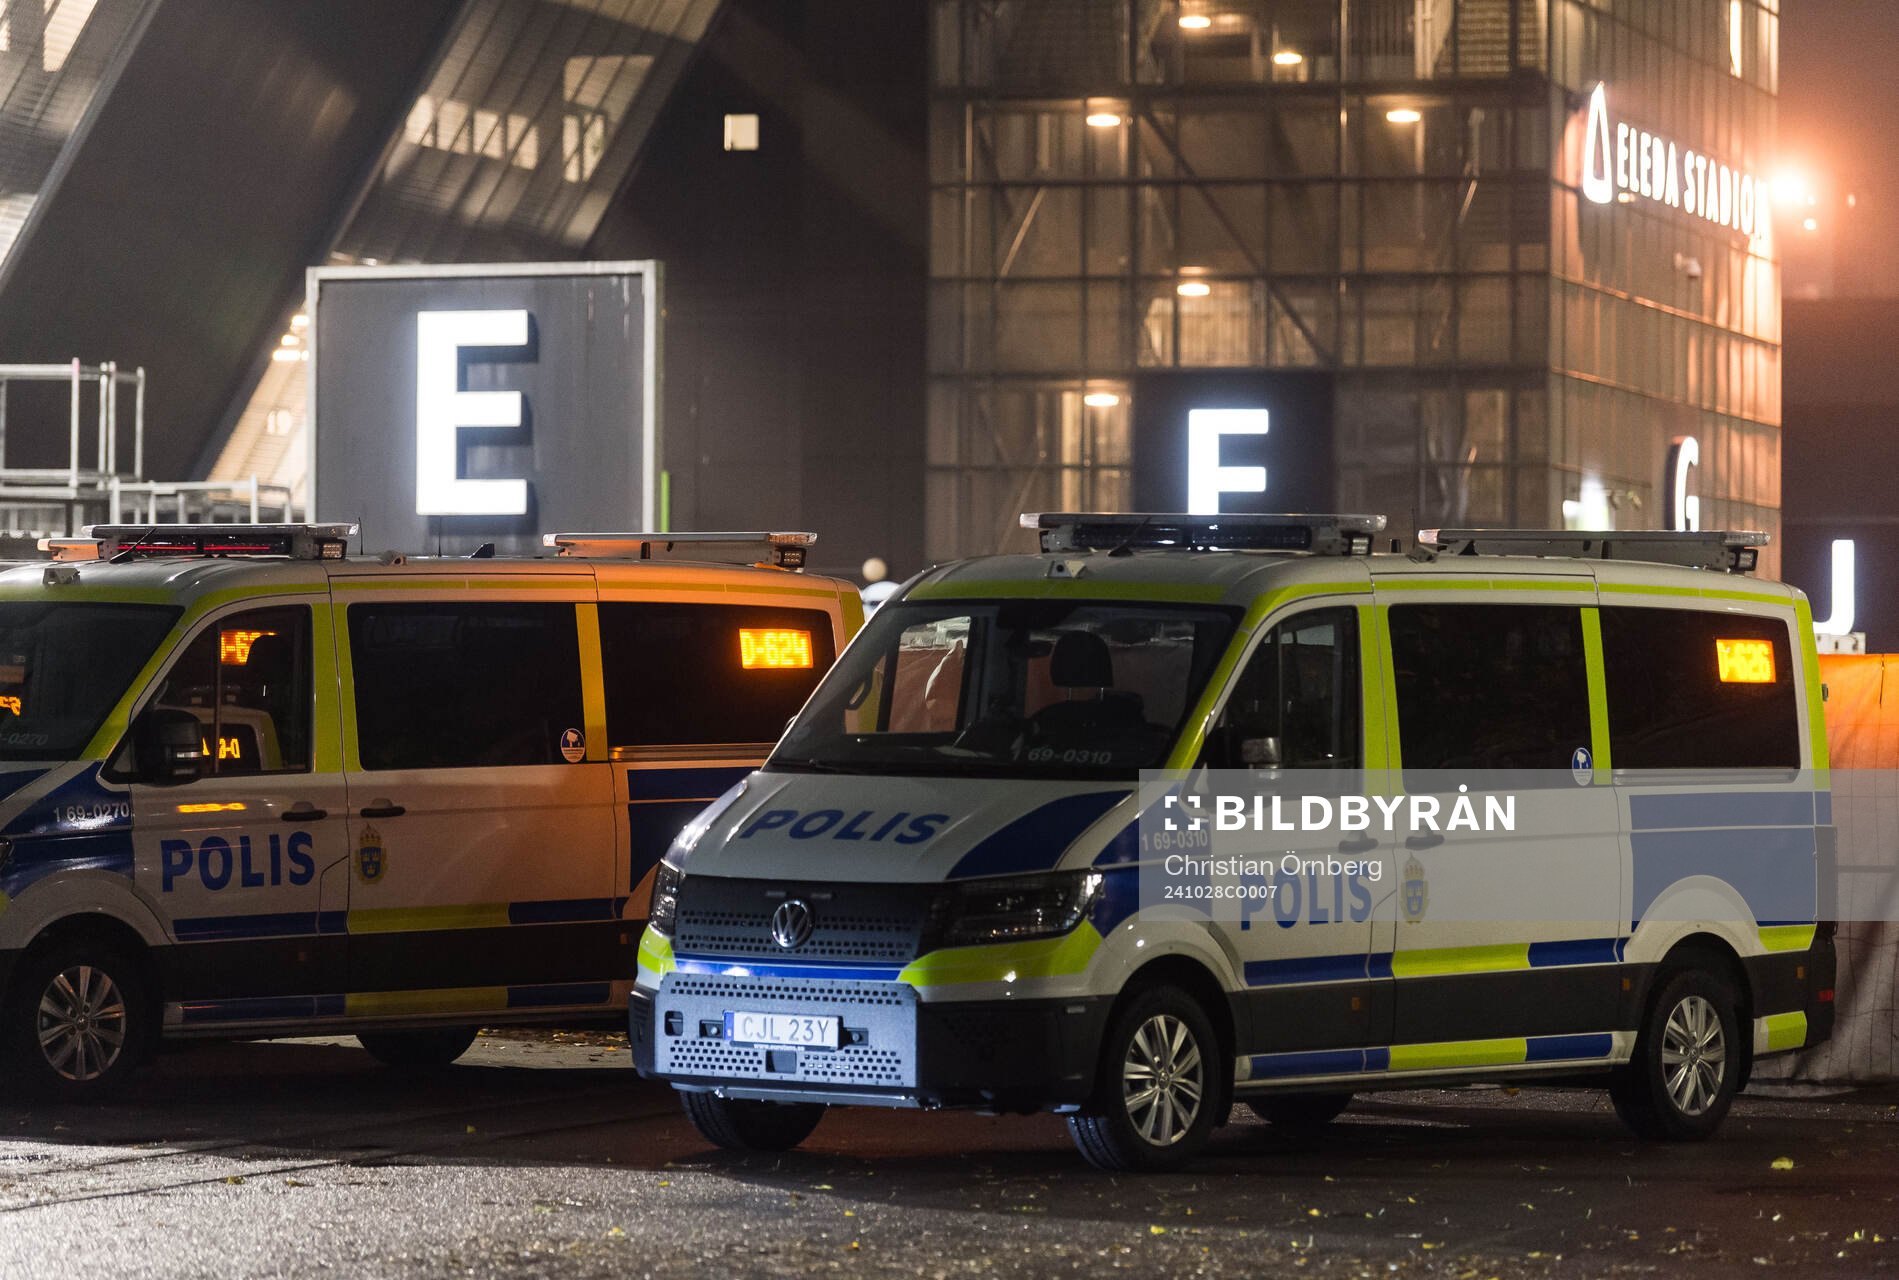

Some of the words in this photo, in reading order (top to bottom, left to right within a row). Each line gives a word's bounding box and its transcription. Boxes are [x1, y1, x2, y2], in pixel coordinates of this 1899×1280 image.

[1617, 122, 1679, 208] ELEDA
[416, 309, 528, 515] E
[1188, 408, 1269, 515] F
[1675, 436, 1699, 532] G
[1812, 539, 1854, 636] J
[1028, 748, 1112, 765] 69-0310
[66, 802, 130, 821] 69-0270
[739, 808, 951, 845] POLIS
[1153, 829, 1208, 850] 69-0310
[160, 831, 315, 893] POLIS
[1239, 863, 1373, 931] POLIS
[743, 1016, 780, 1041] CJL
[789, 1018, 829, 1043] 23Y
